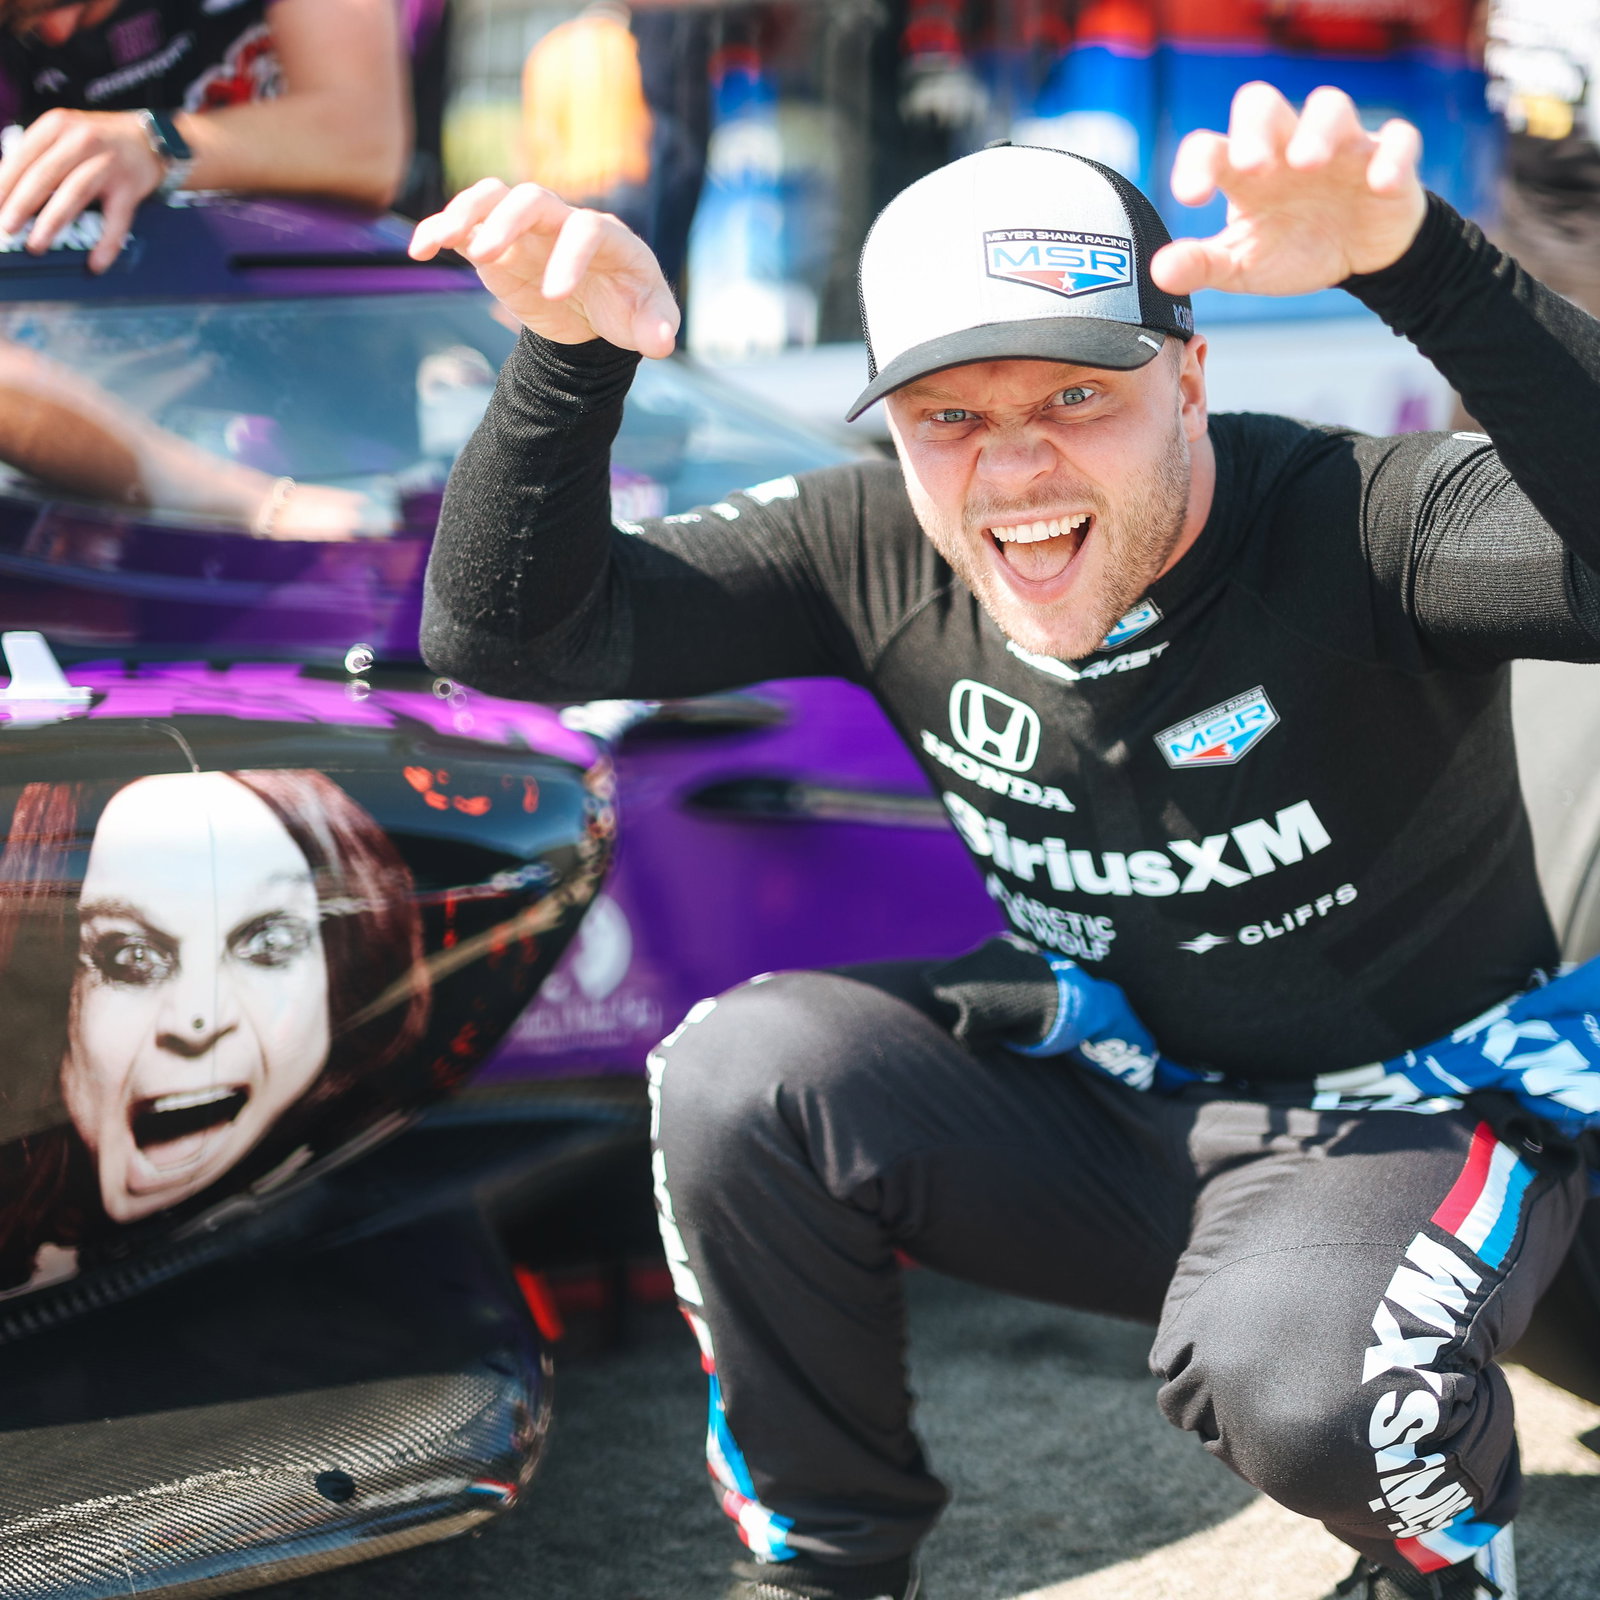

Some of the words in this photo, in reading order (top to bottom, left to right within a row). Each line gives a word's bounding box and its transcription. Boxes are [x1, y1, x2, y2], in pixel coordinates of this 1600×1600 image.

[986, 230, 1035, 242] MEYER
[1036, 232, 1083, 243] SHANK
[1084, 235, 1130, 249] RACING
[993, 245, 1127, 276] MSR
[1170, 703, 1267, 758] MSR
[920, 729, 1076, 813] HONDA
[943, 791, 1333, 897] SiriusXM
[1013, 891, 1117, 941] ARCTIC
[1027, 916, 1111, 962] WOLF
[1237, 883, 1359, 946] CLIFFS
